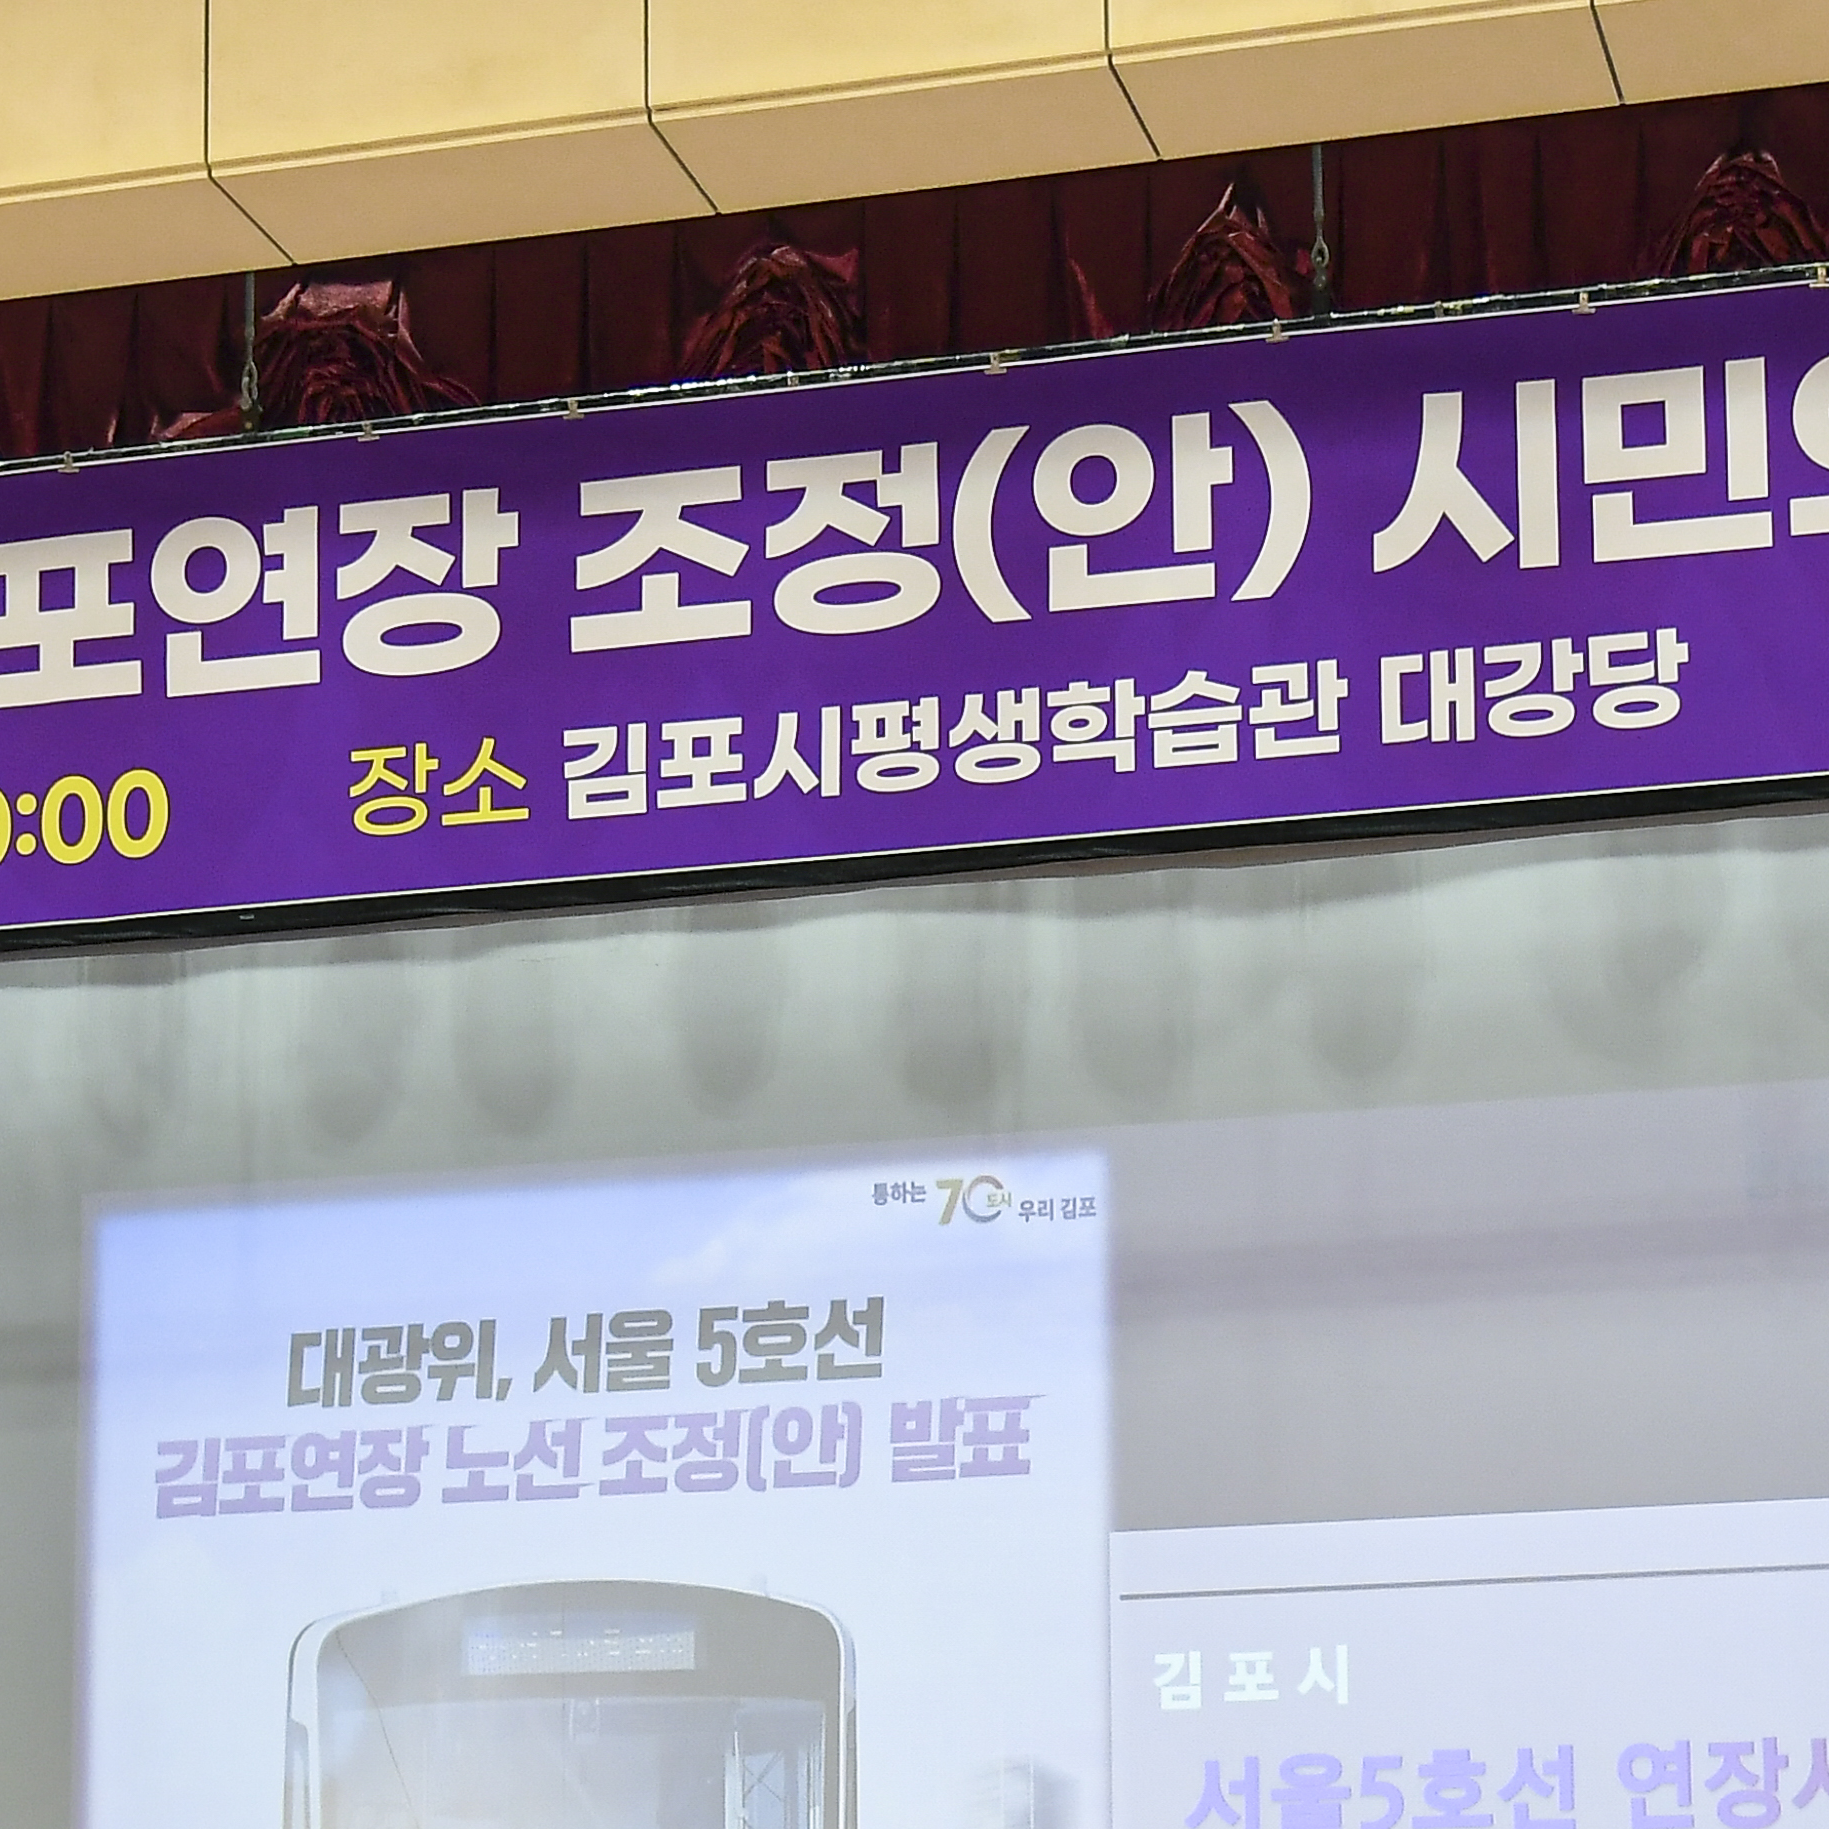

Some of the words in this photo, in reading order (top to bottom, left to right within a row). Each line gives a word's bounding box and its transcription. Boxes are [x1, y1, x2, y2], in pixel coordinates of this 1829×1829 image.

[568, 400, 1311, 655] 조정(안)
[348, 737, 530, 837] 장소
[562, 660, 1349, 823] 김포시평생학습관
[1378, 627, 1690, 745] 대강당
[872, 1181, 927, 1206] 통하는
[986, 1191, 1012, 1208] 도시
[1018, 1198, 1054, 1222] 우리
[1060, 1197, 1096, 1220] 김포
[287, 1317, 512, 1409] 대광위,
[532, 1308, 673, 1396] 서울
[695, 1295, 886, 1388] 5호선
[154, 1423, 435, 1520] 김포연장
[442, 1416, 594, 1505] 노선
[598, 1402, 863, 1497] 조정(안)
[888, 1394, 1047, 1484] 발표
